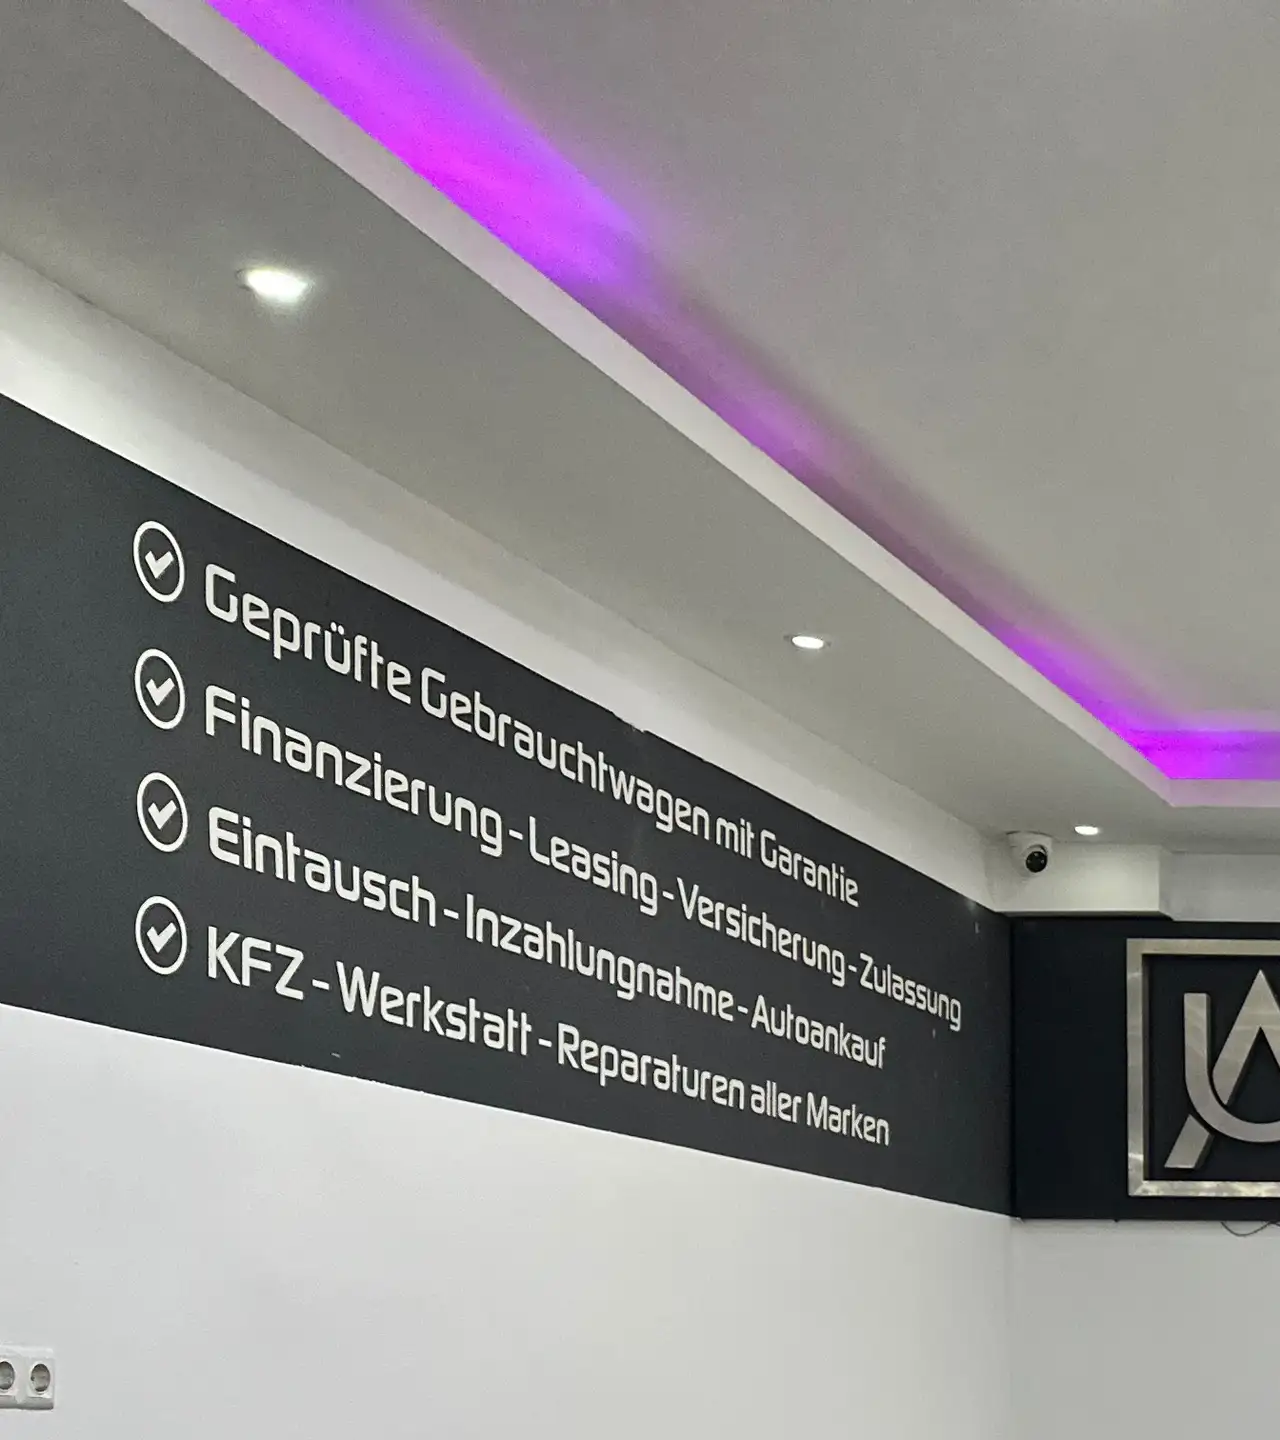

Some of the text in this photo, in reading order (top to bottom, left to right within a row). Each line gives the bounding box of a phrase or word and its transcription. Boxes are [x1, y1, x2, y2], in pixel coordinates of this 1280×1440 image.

[205, 563, 859, 908] Geprüfte Gebrauchtwagen mit Garantie
[557, 1022, 745, 1110] Reparaturen
[750, 1079, 802, 1124] aller
[806, 1091, 890, 1146] Marken
